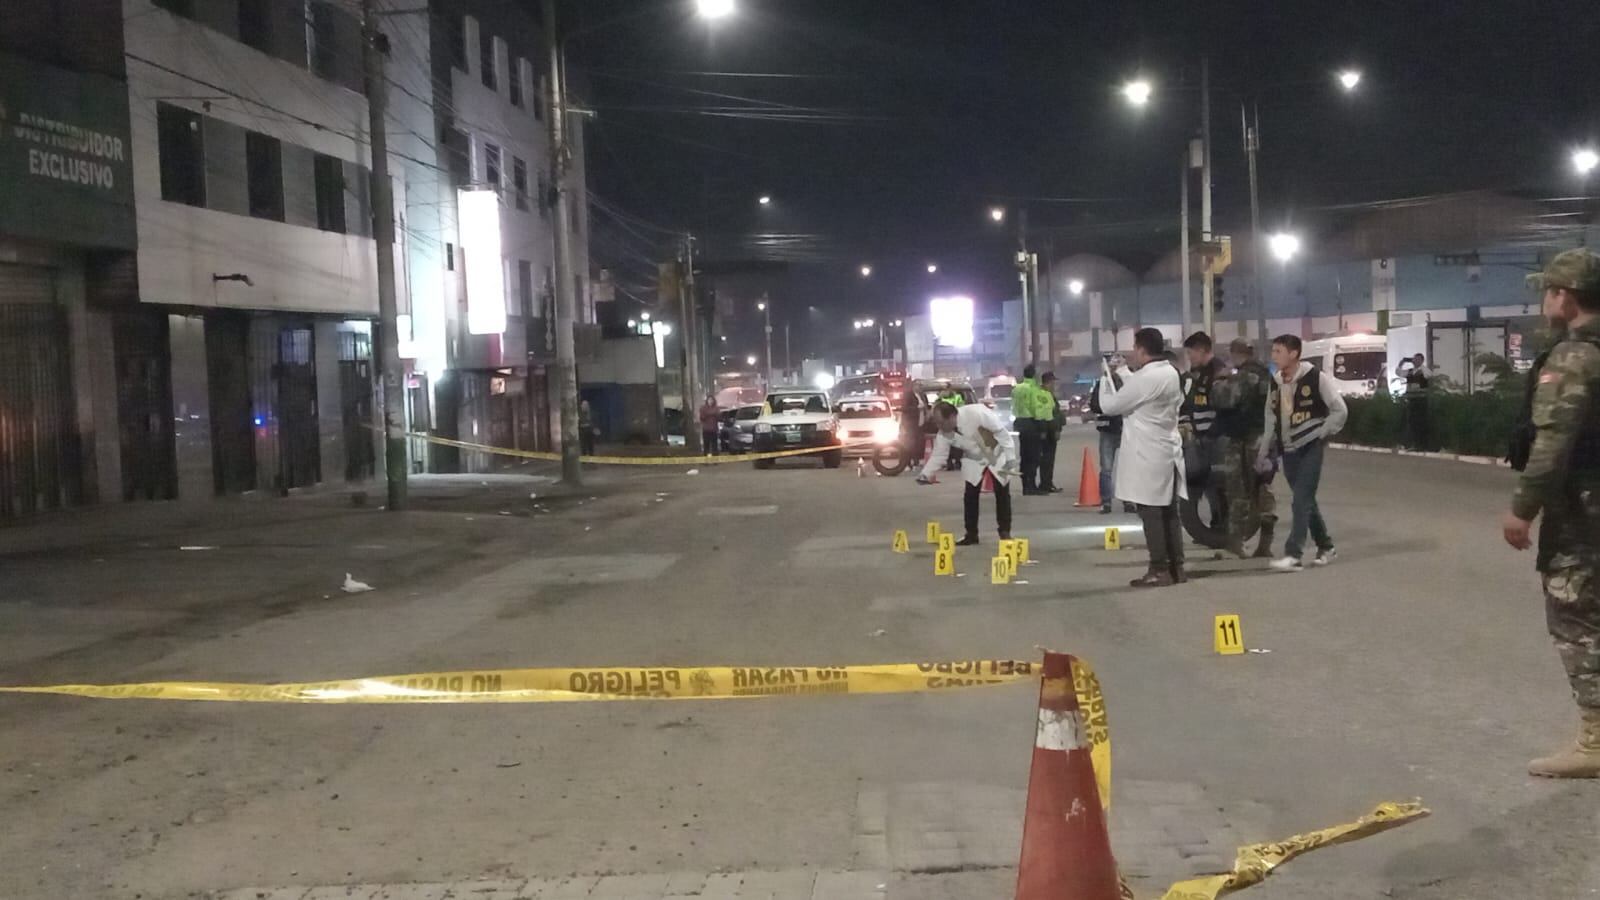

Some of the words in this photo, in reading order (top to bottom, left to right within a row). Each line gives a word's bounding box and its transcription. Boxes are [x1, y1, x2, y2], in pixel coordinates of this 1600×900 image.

[28, 147, 114, 189] EXCLUSIVO
[944, 536, 950, 550] 3
[1109, 530, 1116, 544] 4
[939, 553, 946, 569] 8
[993, 561, 1007, 578] 10
[1219, 619, 1238, 646] 11
